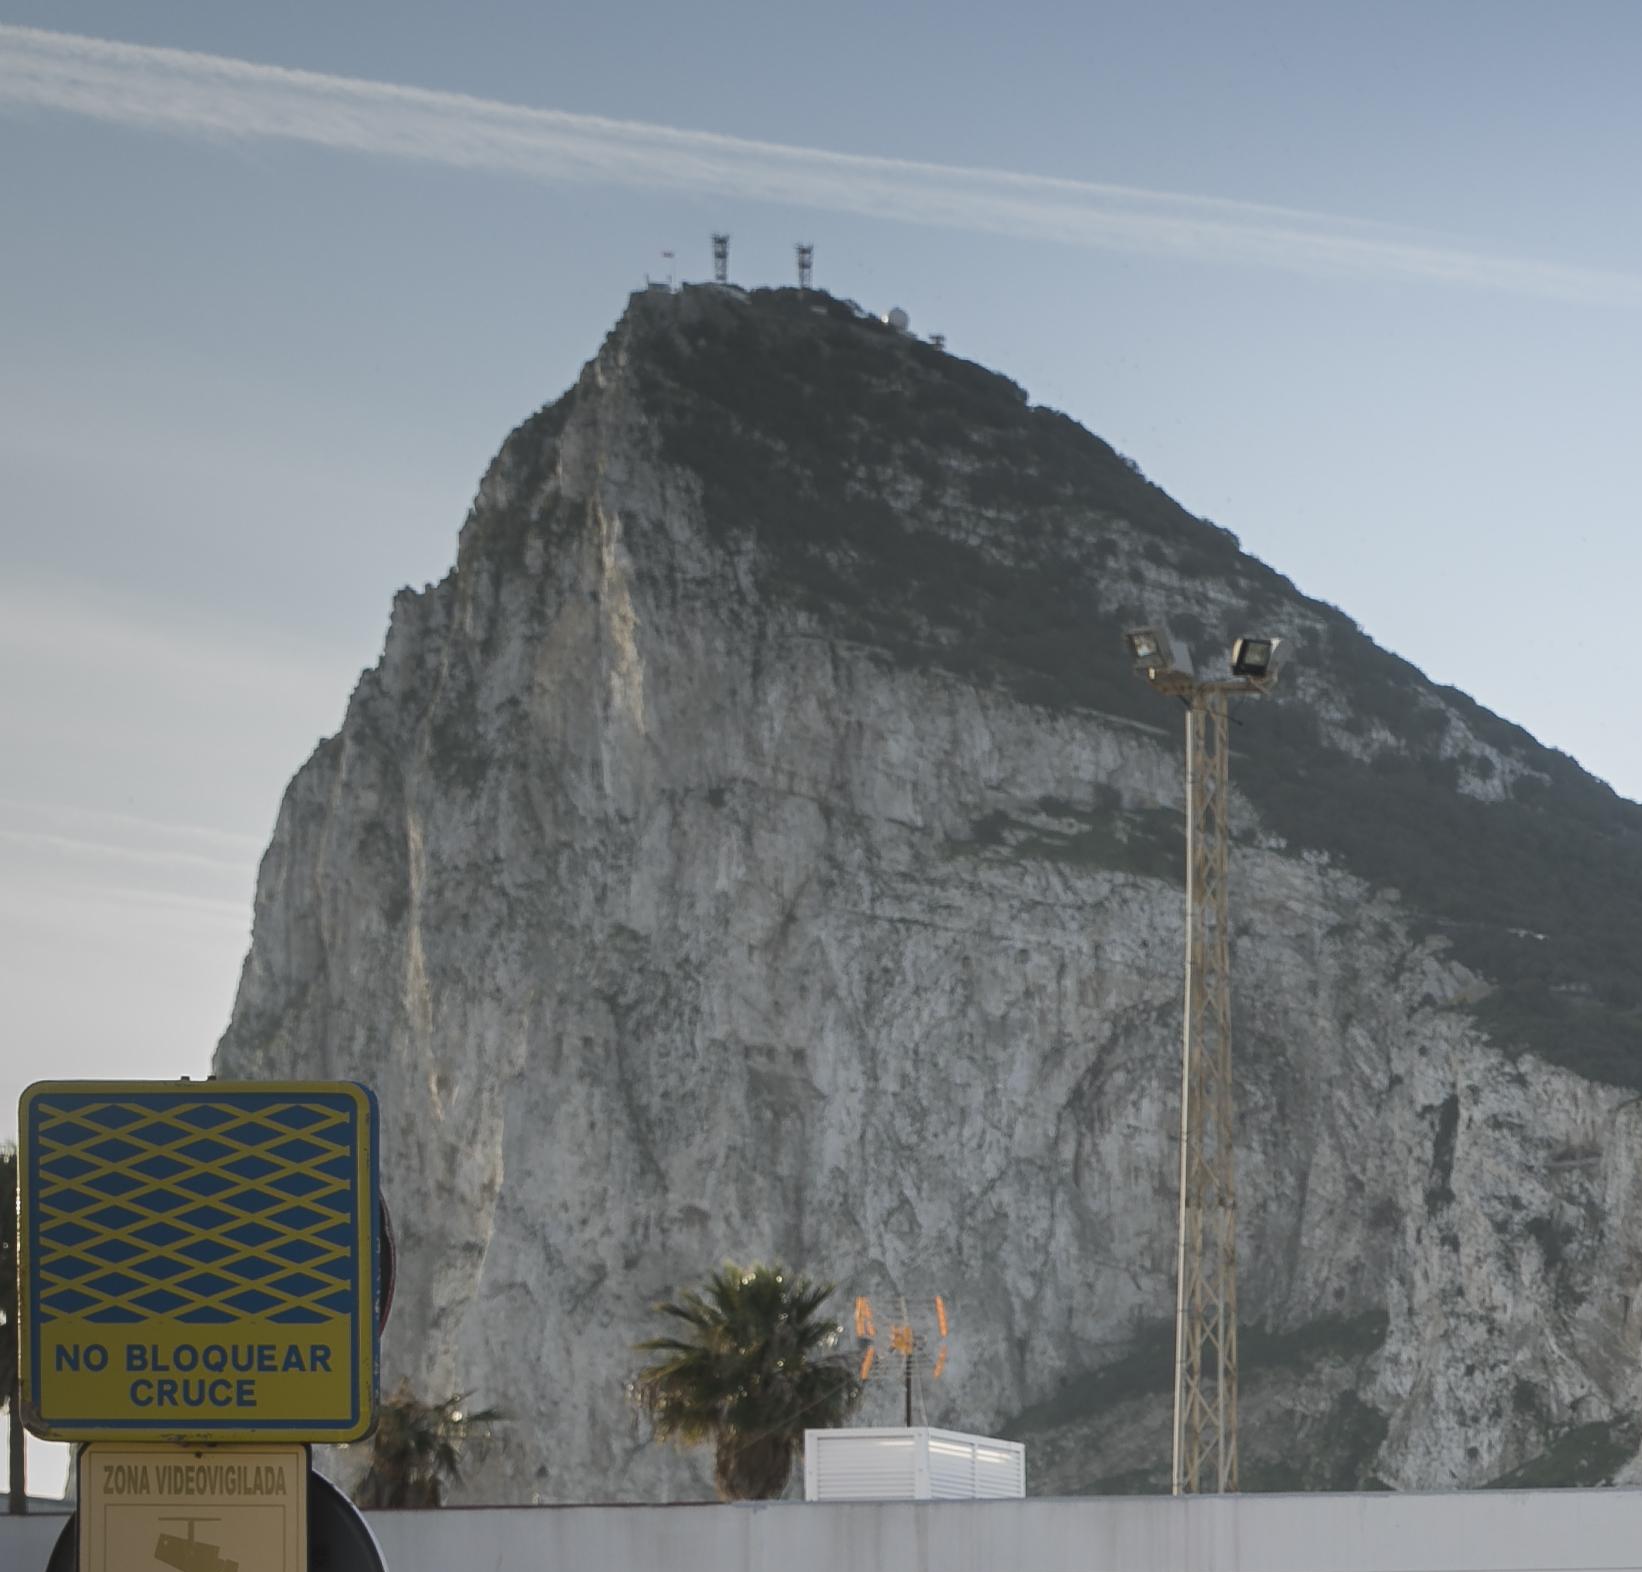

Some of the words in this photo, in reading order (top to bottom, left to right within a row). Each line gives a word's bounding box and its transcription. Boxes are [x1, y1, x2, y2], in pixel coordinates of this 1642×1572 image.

[55, 1344, 109, 1372] NO
[126, 1344, 332, 1373] BLOQUEAR
[129, 1379, 257, 1407] CRUCE
[103, 1465, 150, 1495] ZONA
[155, 1464, 287, 1496] VIDEOVIGILADA
